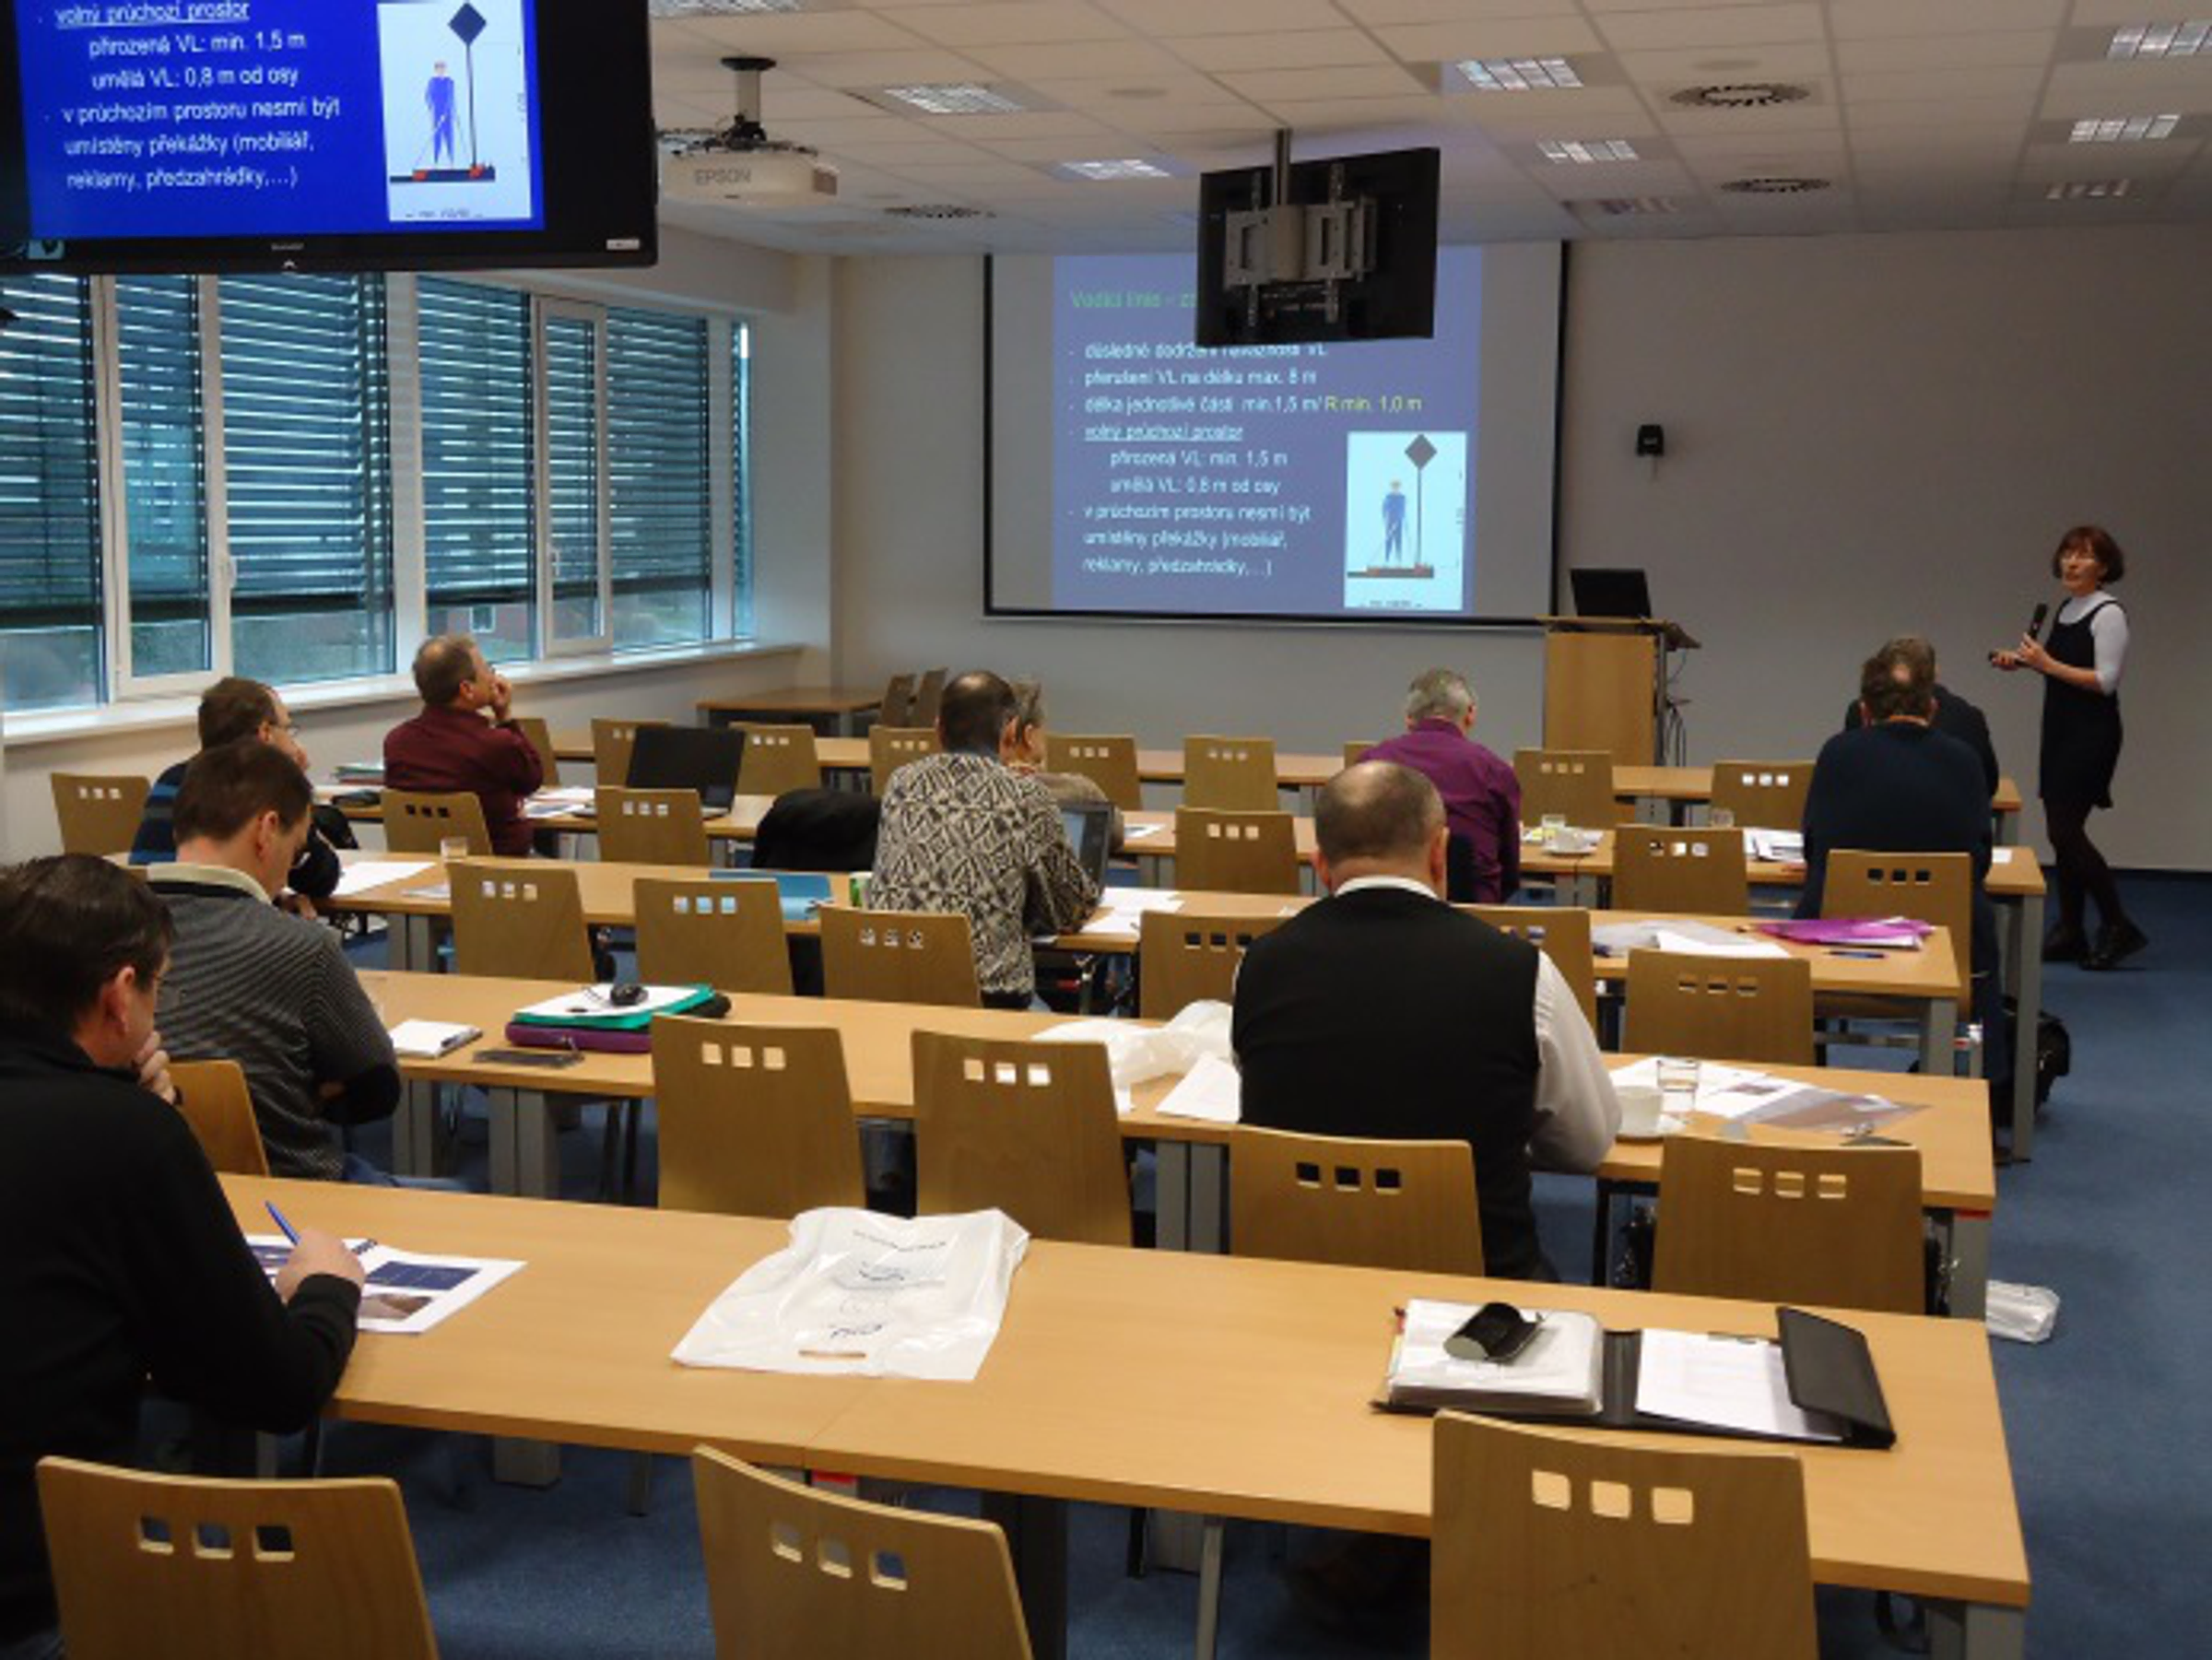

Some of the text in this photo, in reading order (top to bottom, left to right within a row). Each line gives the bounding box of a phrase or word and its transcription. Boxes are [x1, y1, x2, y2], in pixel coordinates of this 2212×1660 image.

[184, 66, 213, 88] 0,8
[239, 65, 264, 85] od
[267, 67, 299, 88] osy
[695, 169, 751, 185] EPSON
